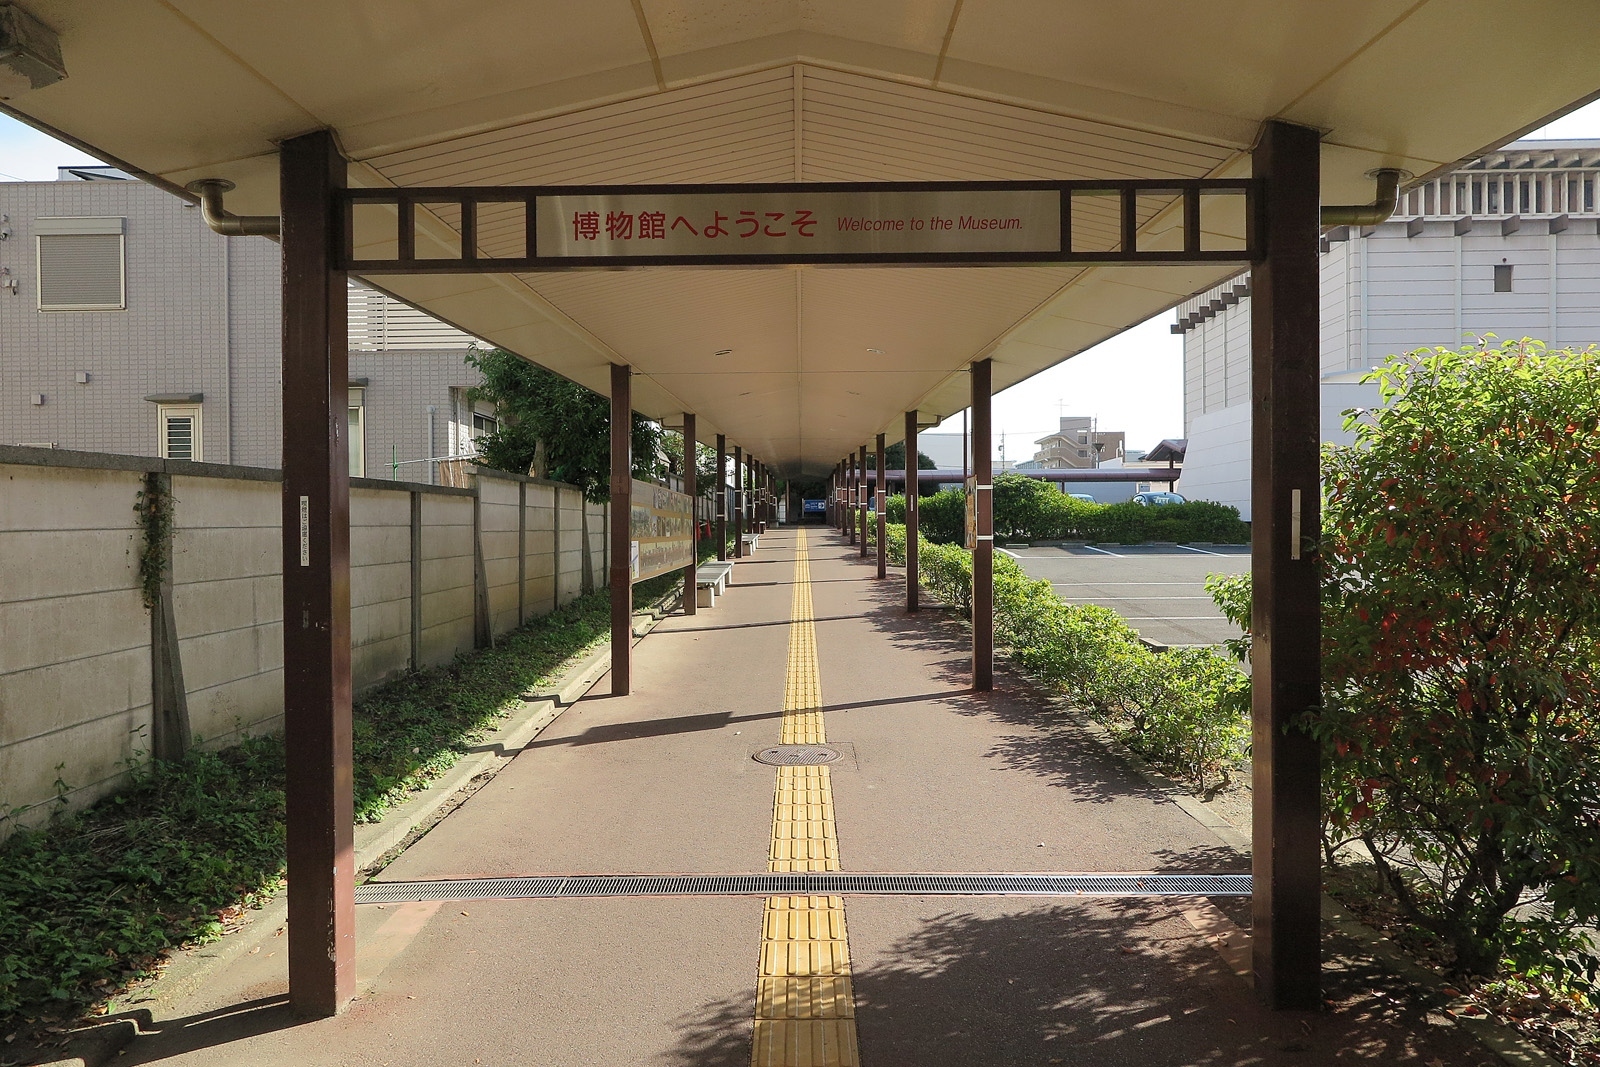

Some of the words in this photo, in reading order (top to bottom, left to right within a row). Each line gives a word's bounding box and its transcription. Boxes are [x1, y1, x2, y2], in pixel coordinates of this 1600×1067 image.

[572, 210, 818, 241] 博物館へようこそ
[837, 217, 904, 231] Welcome
[910, 217, 924, 231] to
[930, 216, 953, 230] the
[958, 216, 1023, 230] Museum.
